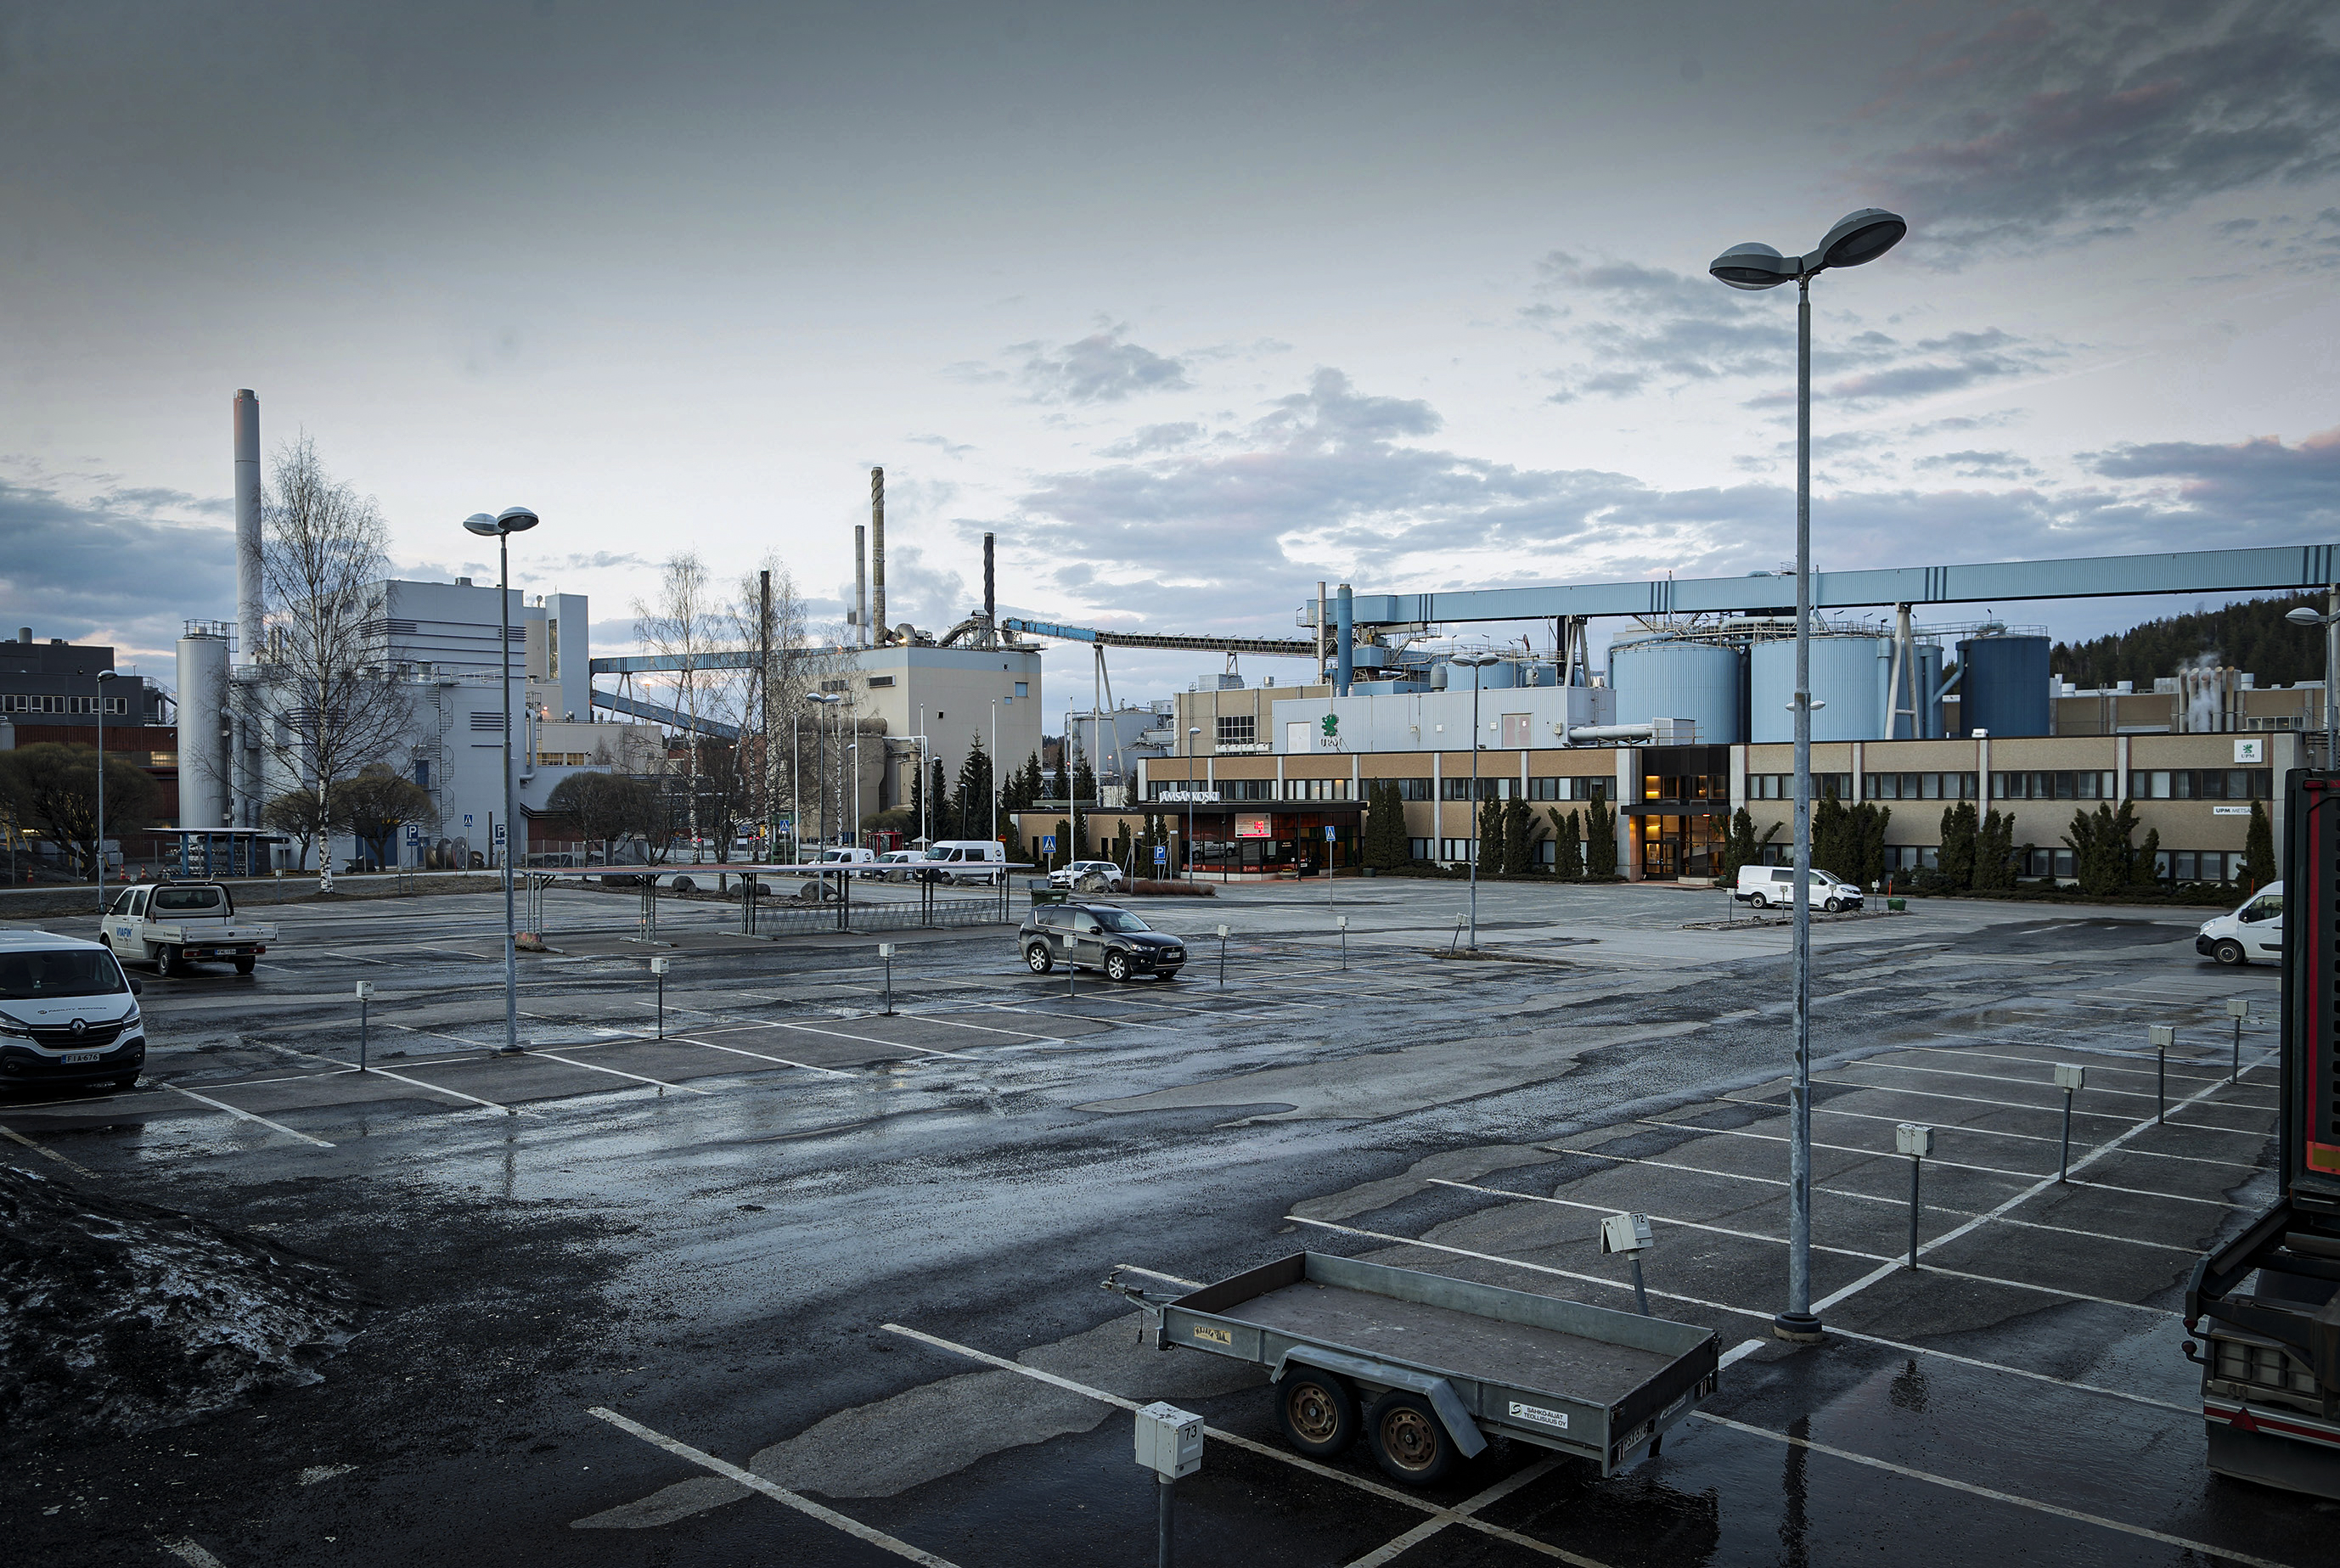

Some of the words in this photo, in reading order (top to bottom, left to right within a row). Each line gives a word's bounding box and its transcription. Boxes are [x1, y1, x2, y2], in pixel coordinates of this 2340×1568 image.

[1159, 790, 1219, 803] JÄMSÄNKOSKI
[1156, 846, 1164, 857] P
[116, 926, 132, 937] VIAFIN
[68, 1054, 98, 1063] FIA-676
[1634, 1214, 1645, 1223] 72
[1524, 1412, 1558, 1425] TEOLLISUUS
[1184, 1425, 1197, 1441] 73
